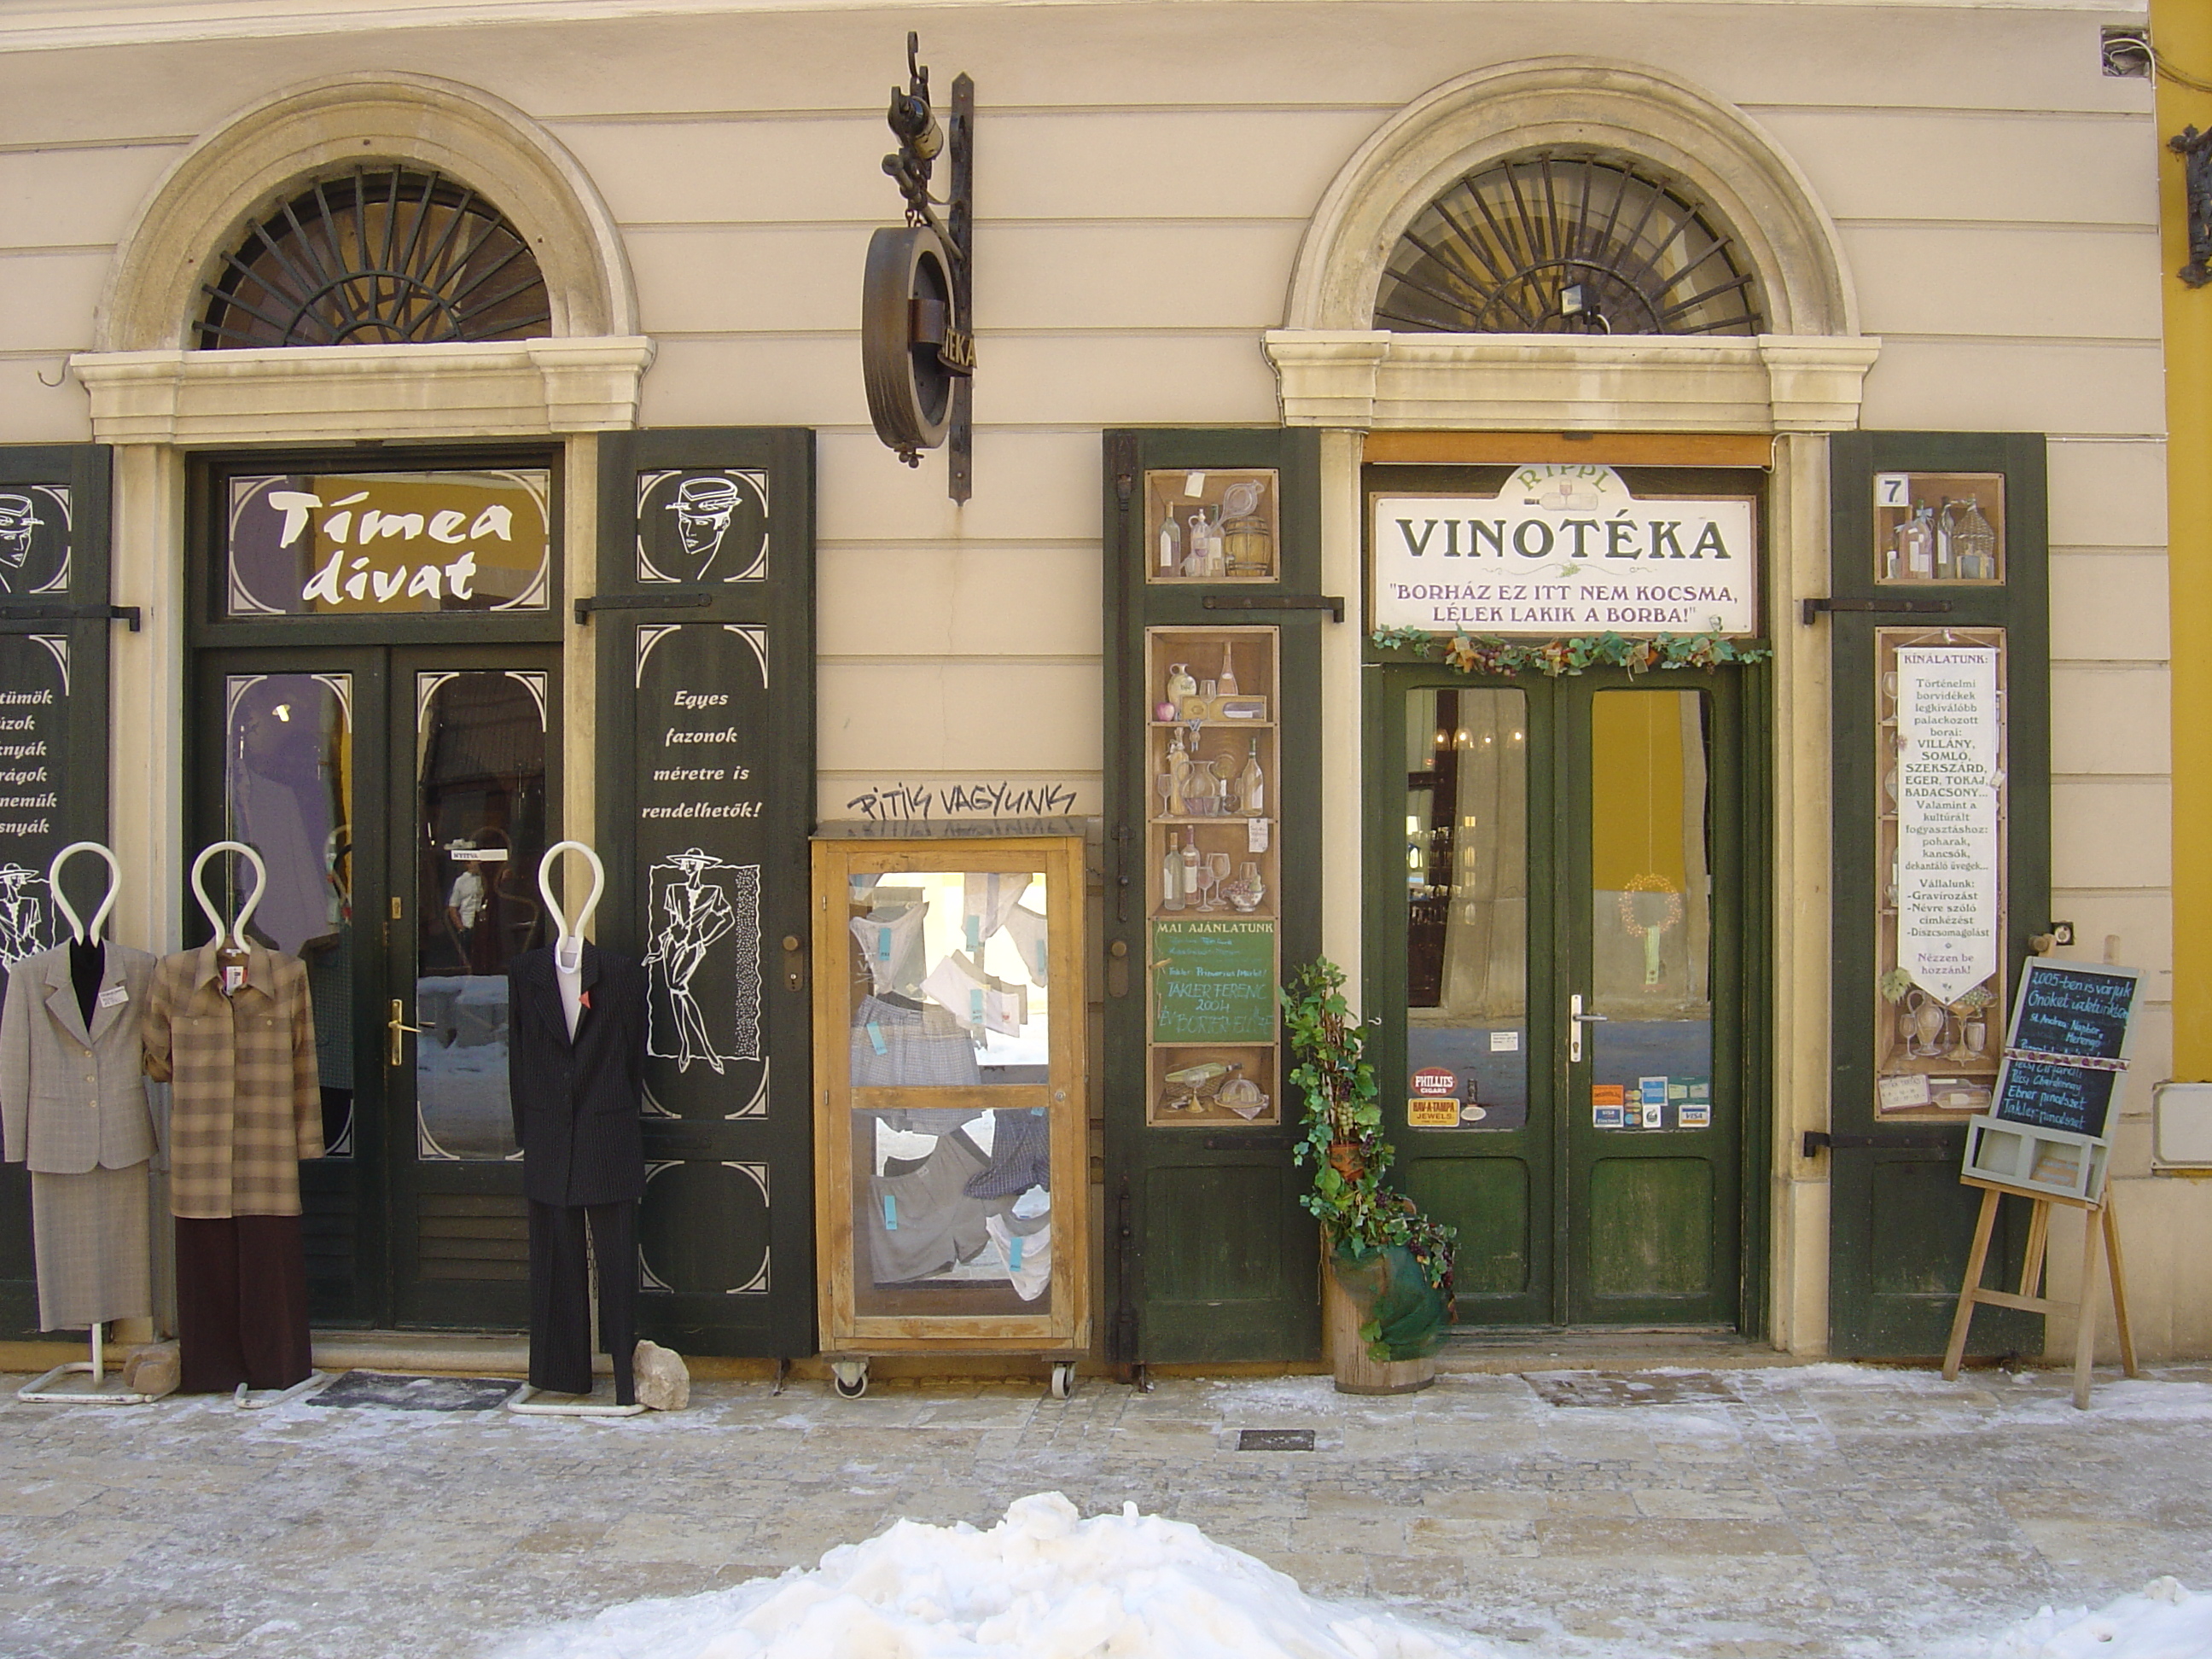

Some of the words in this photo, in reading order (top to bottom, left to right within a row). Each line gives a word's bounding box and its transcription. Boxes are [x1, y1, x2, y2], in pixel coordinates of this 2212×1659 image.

[268, 491, 513, 549] Tímea
[1395, 509, 1731, 560] VINOTÉKA
[1390, 581, 1491, 600] "BORHÁZ
[1499, 585, 1527, 600] EZ
[1534, 585, 1571, 601] ITT
[1580, 586, 1629, 601] NEM
[1636, 586, 1738, 604] KOCSMA,
[1433, 602, 1503, 622] LÉLEK
[1511, 607, 1575, 622] LAKIK
[1585, 607, 1599, 622] A
[1607, 607, 1696, 622] BORBA!"
[1904, 653, 1988, 664] KÍNÁLATUNK:
[1916, 678, 1976, 688] Történelmi
[674, 690, 729, 709] Egyes
[1917, 691, 1976, 701] borvidékek
[1914, 716, 1978, 725] palackozott
[665, 727, 738, 747] fazonok
[1930, 728, 1962, 736] borai:
[1918, 737, 1976, 749] VILLÁNY,
[654, 766, 725, 781] méretre
[733, 765, 749, 780] is
[1906, 762, 1988, 774] SZEKSZÁRD,
[1905, 776, 1942, 786] EGER,
[1946, 776, 1988, 786] TOKAJ,
[642, 801, 763, 818] rendelhetők!
[1917, 800, 1967, 809] Valamint
[1922, 837, 1970, 847] poharak,
[1919, 879, 1975, 888] Vállalunk:
[1160, 923, 1182, 933] MAI
[1188, 922, 1274, 933] AJÁNLATUNK
[1918, 953, 1959, 963] Nézzen
[1962, 953, 1974, 963] be
[1921, 965, 1970, 975] hozzánk!
[1167, 981, 1212, 999] TAKLER
[1213, 983, 1266, 999] FERENC
[1196, 998, 1230, 1013] 2004
[1415, 1075, 1453, 1087] PHILLIES
